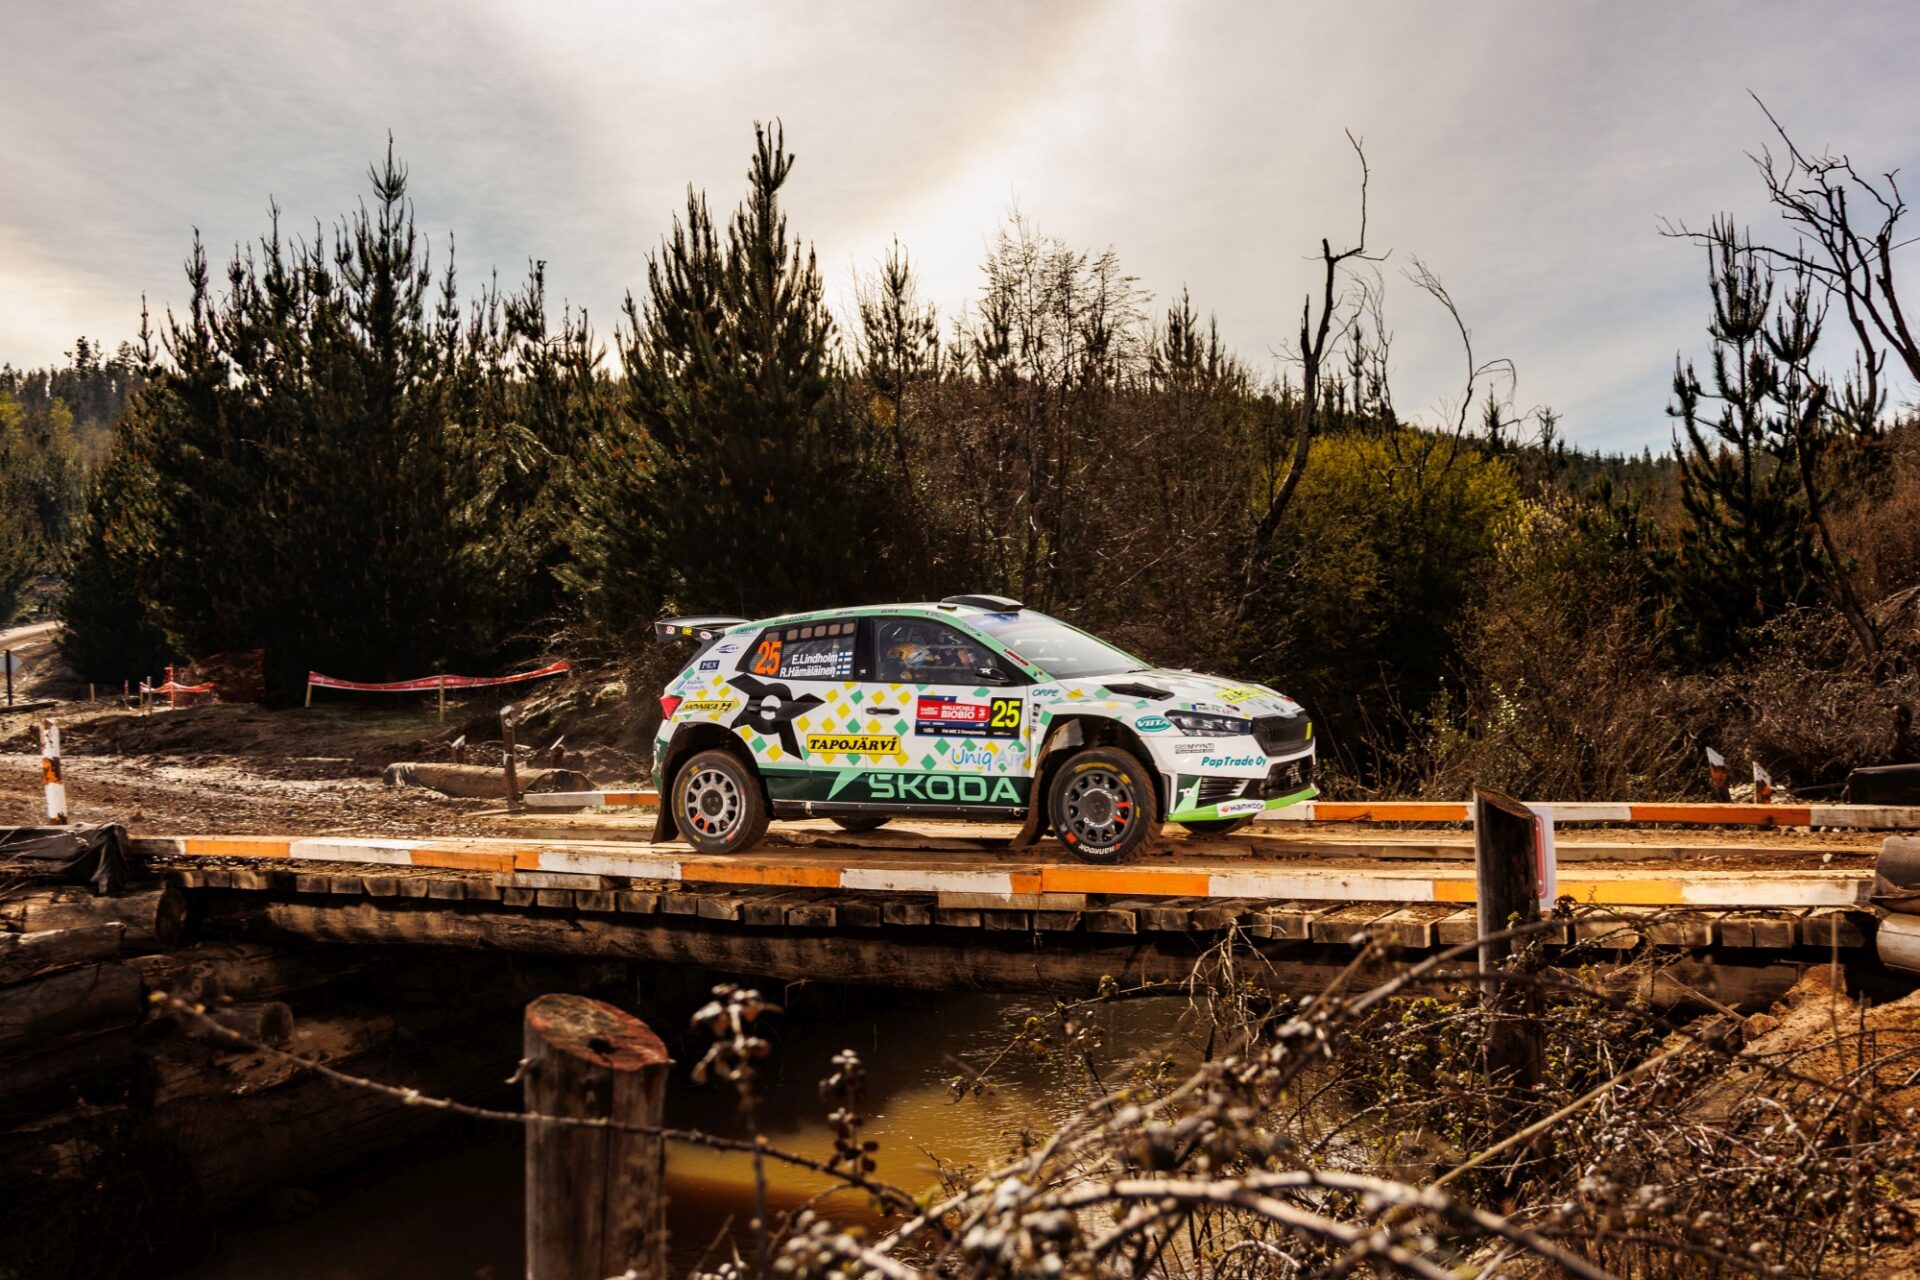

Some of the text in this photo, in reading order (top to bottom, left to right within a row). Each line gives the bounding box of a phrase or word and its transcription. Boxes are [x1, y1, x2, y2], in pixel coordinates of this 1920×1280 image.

[753, 640, 783, 676] 25
[791, 653, 839, 665] E.Lindholm
[779, 666, 837, 677] R.Hämäläinen
[990, 700, 1021, 728] 25
[951, 746, 993, 771] Uniq
[1201, 756, 1254, 767] PapTrade
